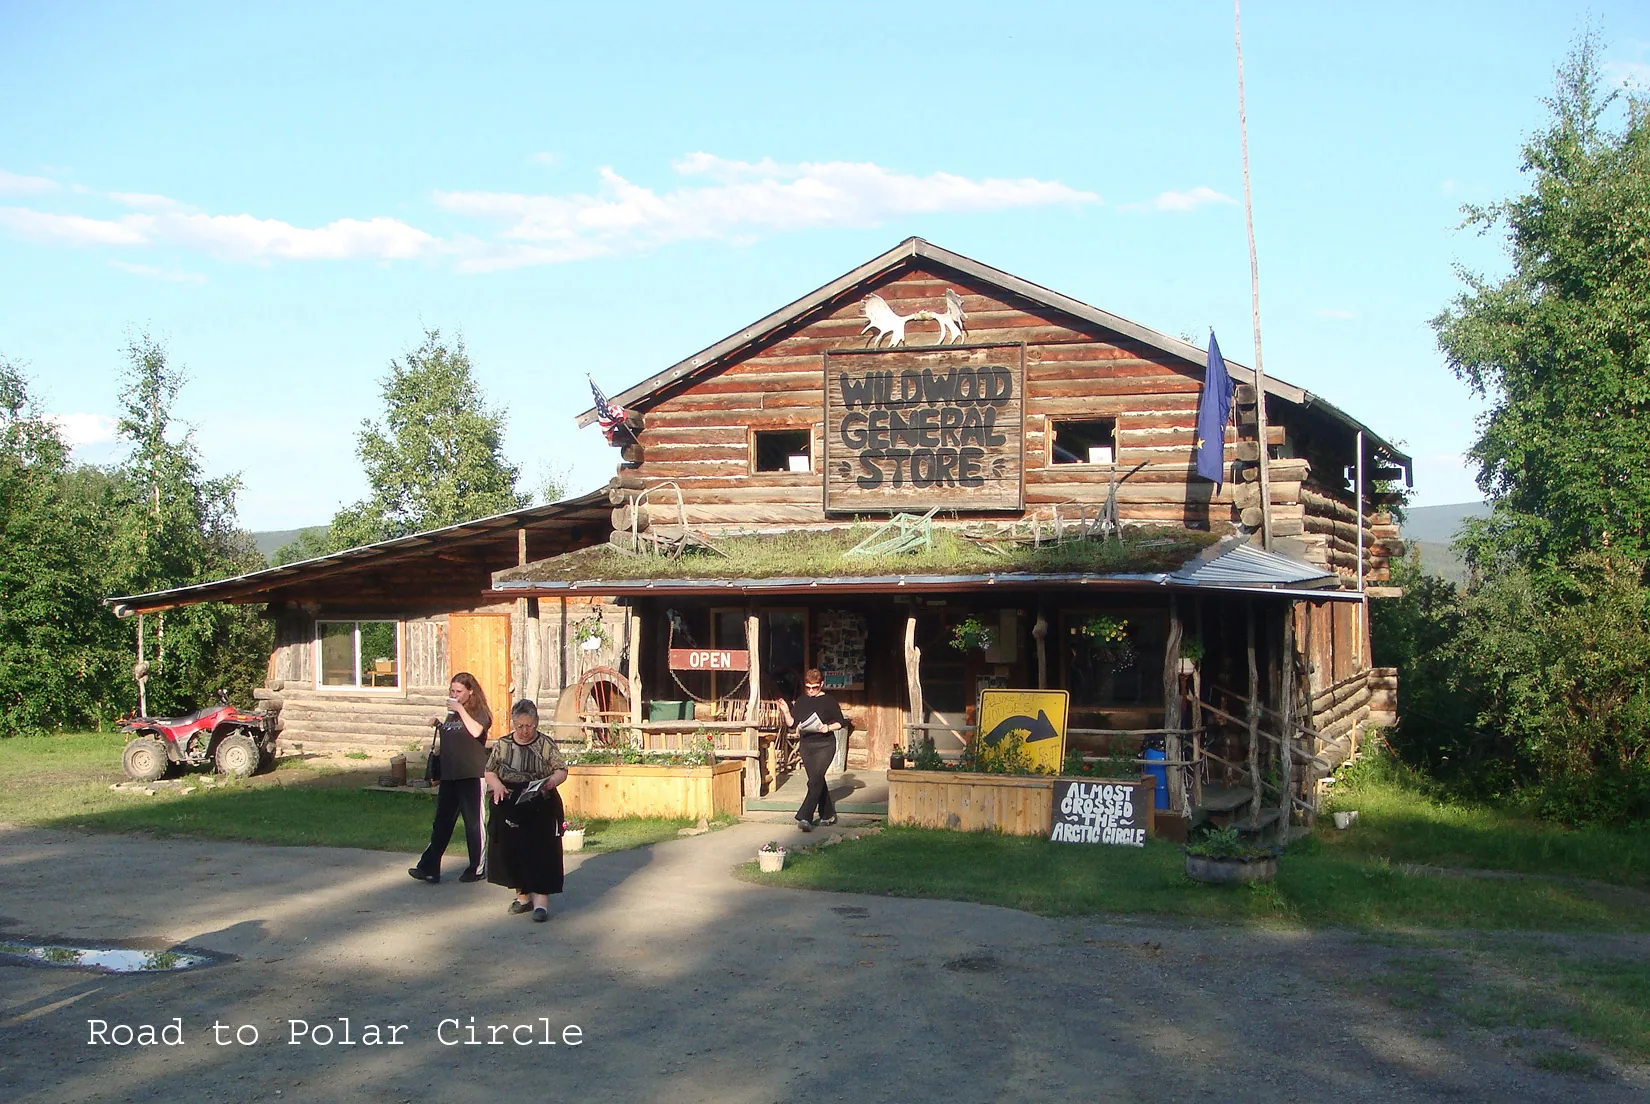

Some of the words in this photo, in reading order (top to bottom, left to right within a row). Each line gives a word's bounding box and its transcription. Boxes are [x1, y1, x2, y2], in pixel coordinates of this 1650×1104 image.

[839, 366, 1013, 411] WILDWOOD
[840, 407, 1007, 450] GENERAL
[856, 447, 986, 490] STORE
[689, 651, 731, 668] OPEN
[983, 702, 1033, 725] HOUSES
[1066, 782, 1134, 802] ALMOST
[1060, 797, 1133, 818] CROSSED
[1082, 812, 1119, 828] THE
[1051, 822, 1101, 844] ARCTIC
[1102, 828, 1146, 848] CIRCLE
